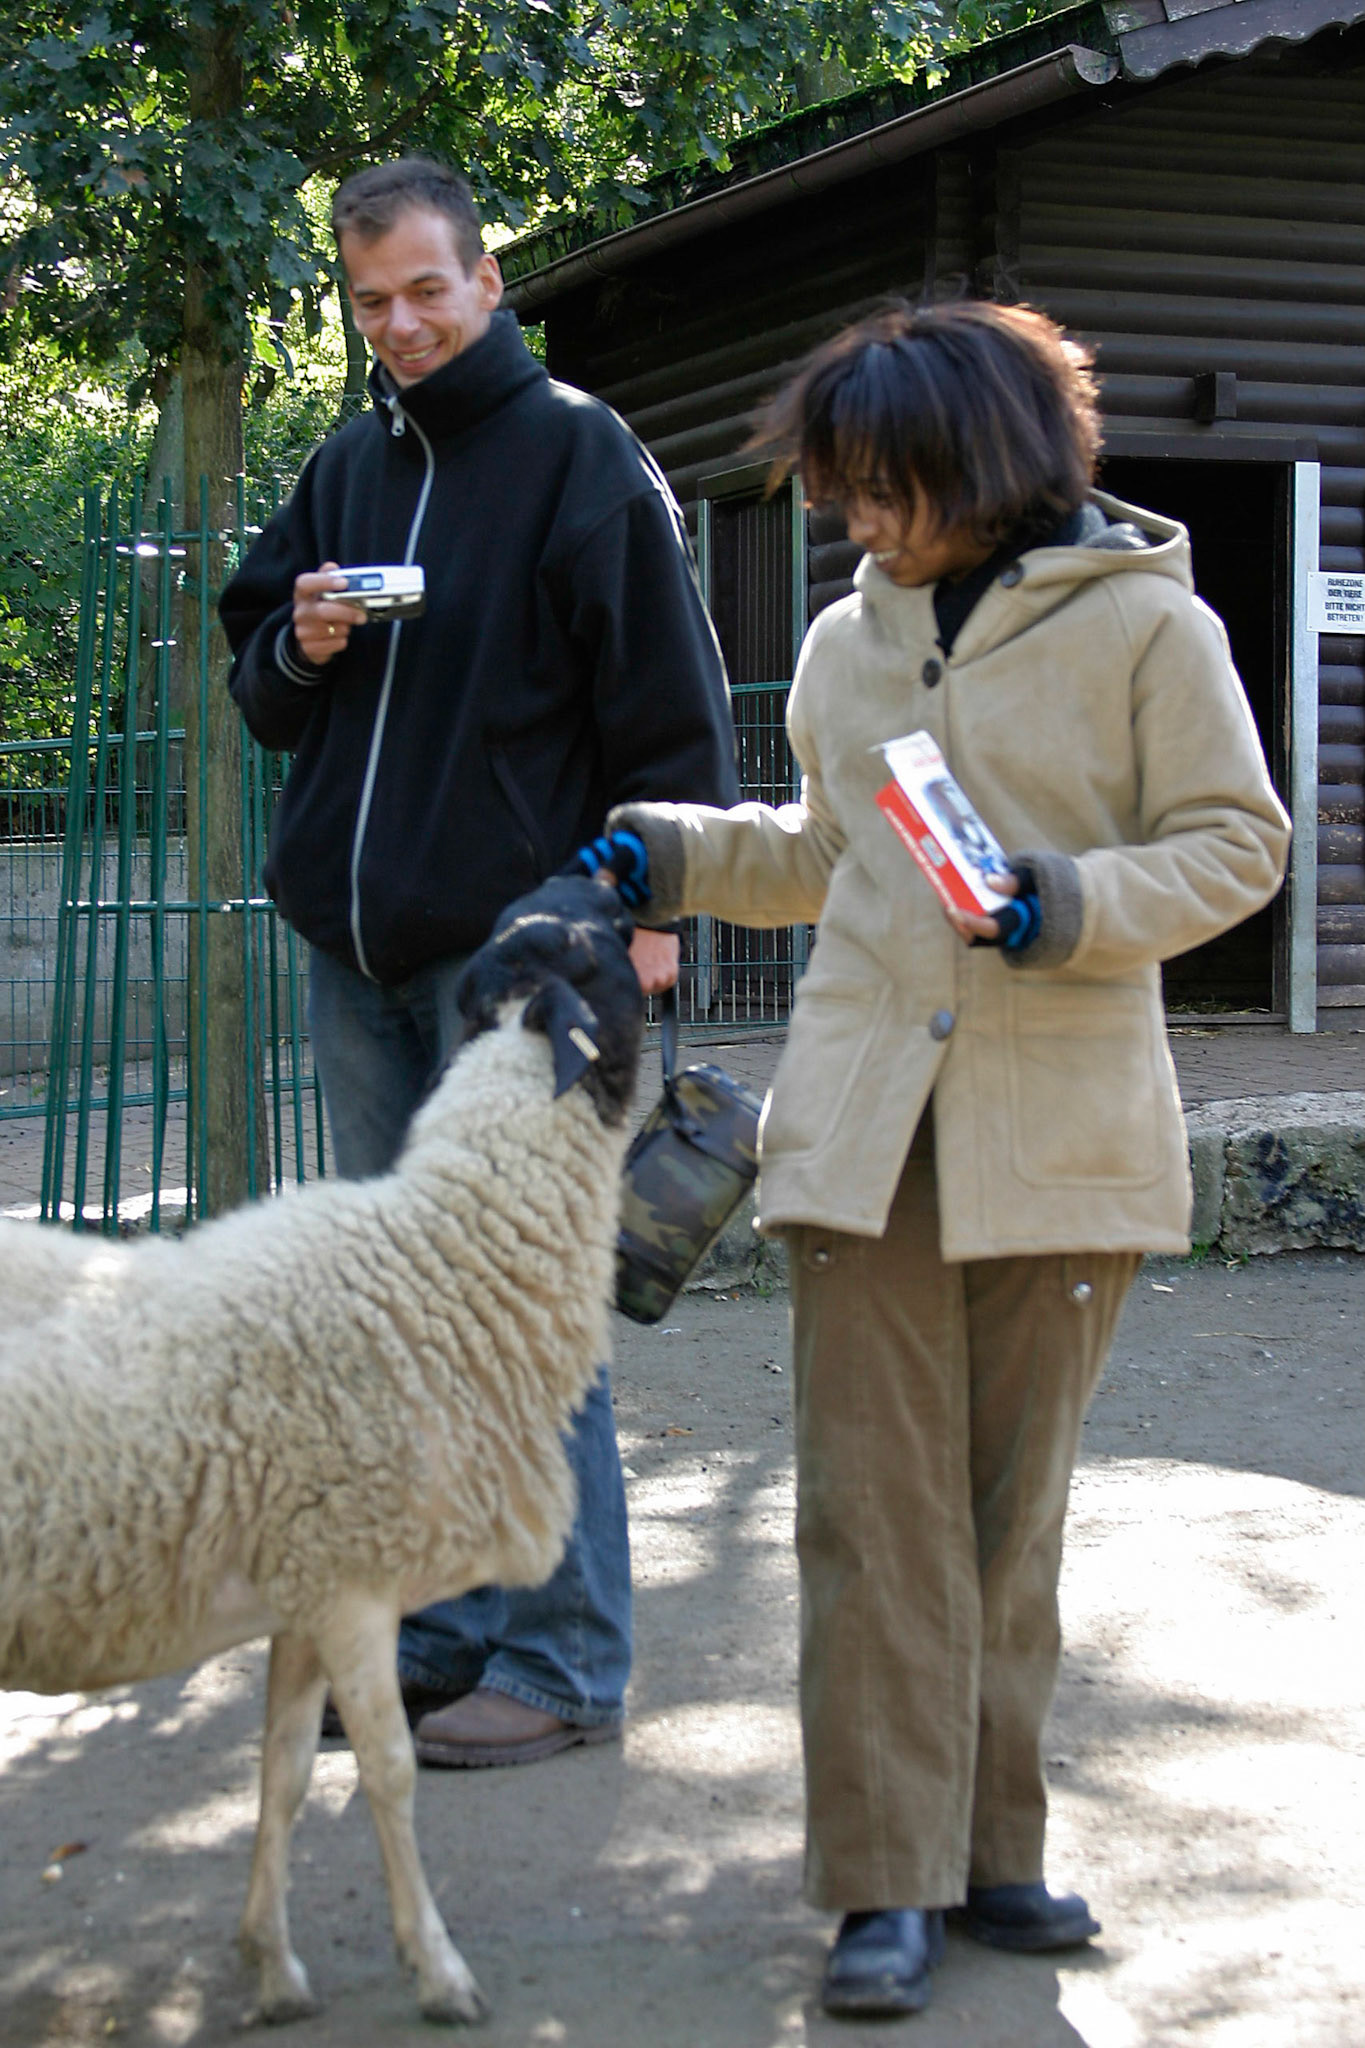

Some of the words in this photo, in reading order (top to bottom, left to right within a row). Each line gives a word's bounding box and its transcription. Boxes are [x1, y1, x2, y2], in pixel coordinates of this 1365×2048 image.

[1328, 589, 1342, 597] DER
[1325, 602, 1344, 610] BITTE
[1345, 603, 1365, 611] NICHT
[1327, 613, 1363, 622] BETRETEN!
